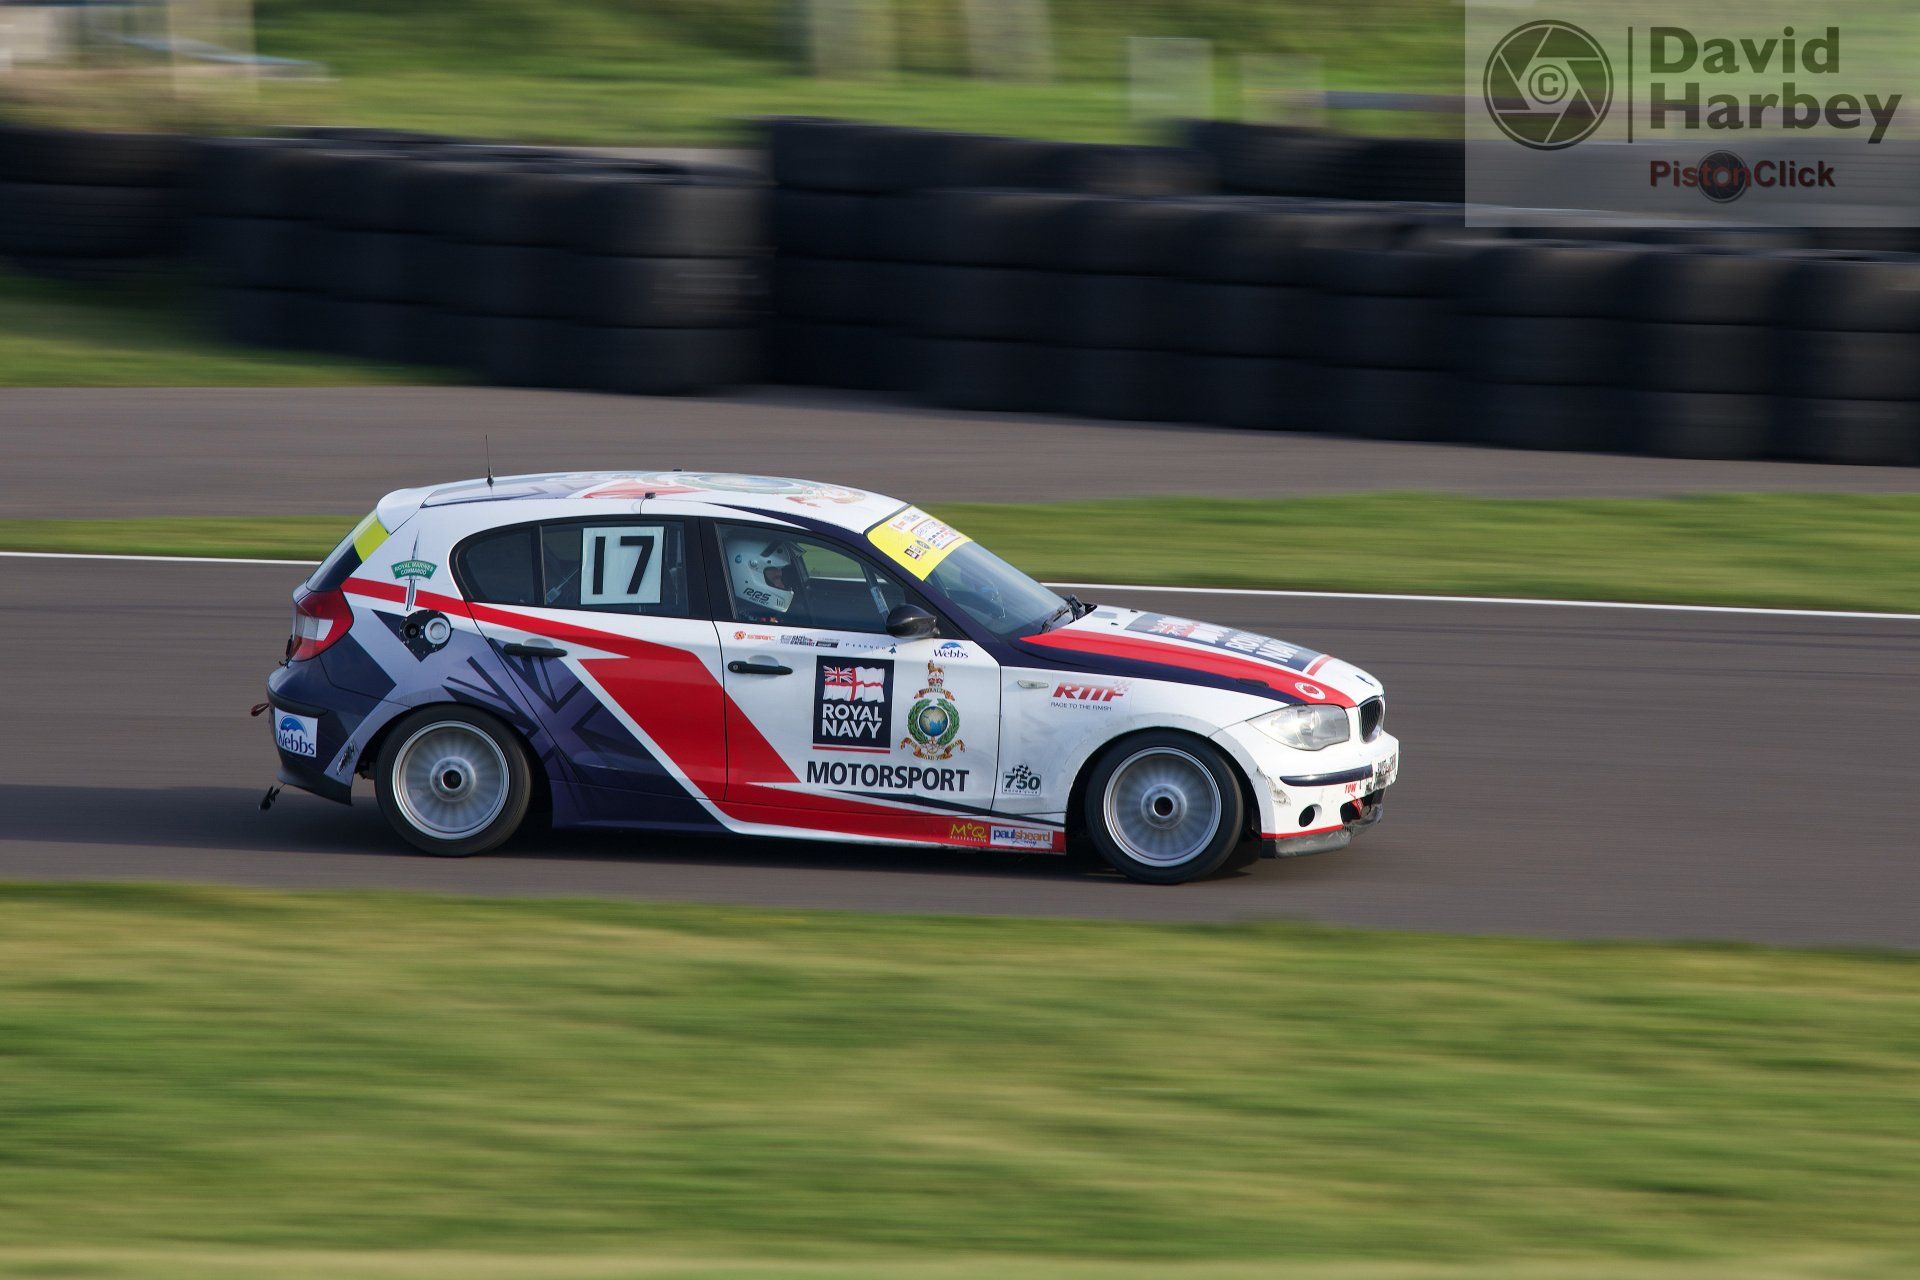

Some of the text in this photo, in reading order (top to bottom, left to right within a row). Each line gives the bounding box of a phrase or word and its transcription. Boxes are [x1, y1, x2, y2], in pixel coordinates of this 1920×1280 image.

[593, 535, 654, 595] 17
[934, 648, 969, 659] Webbs
[822, 704, 882, 722] ROYAL
[821, 719, 881, 739] NAVY
[278, 730, 315, 755] Webbs
[806, 760, 970, 792] MOTORSPORT
[1005, 774, 1041, 791] 750
[1344, 783, 1358, 795] TOW
